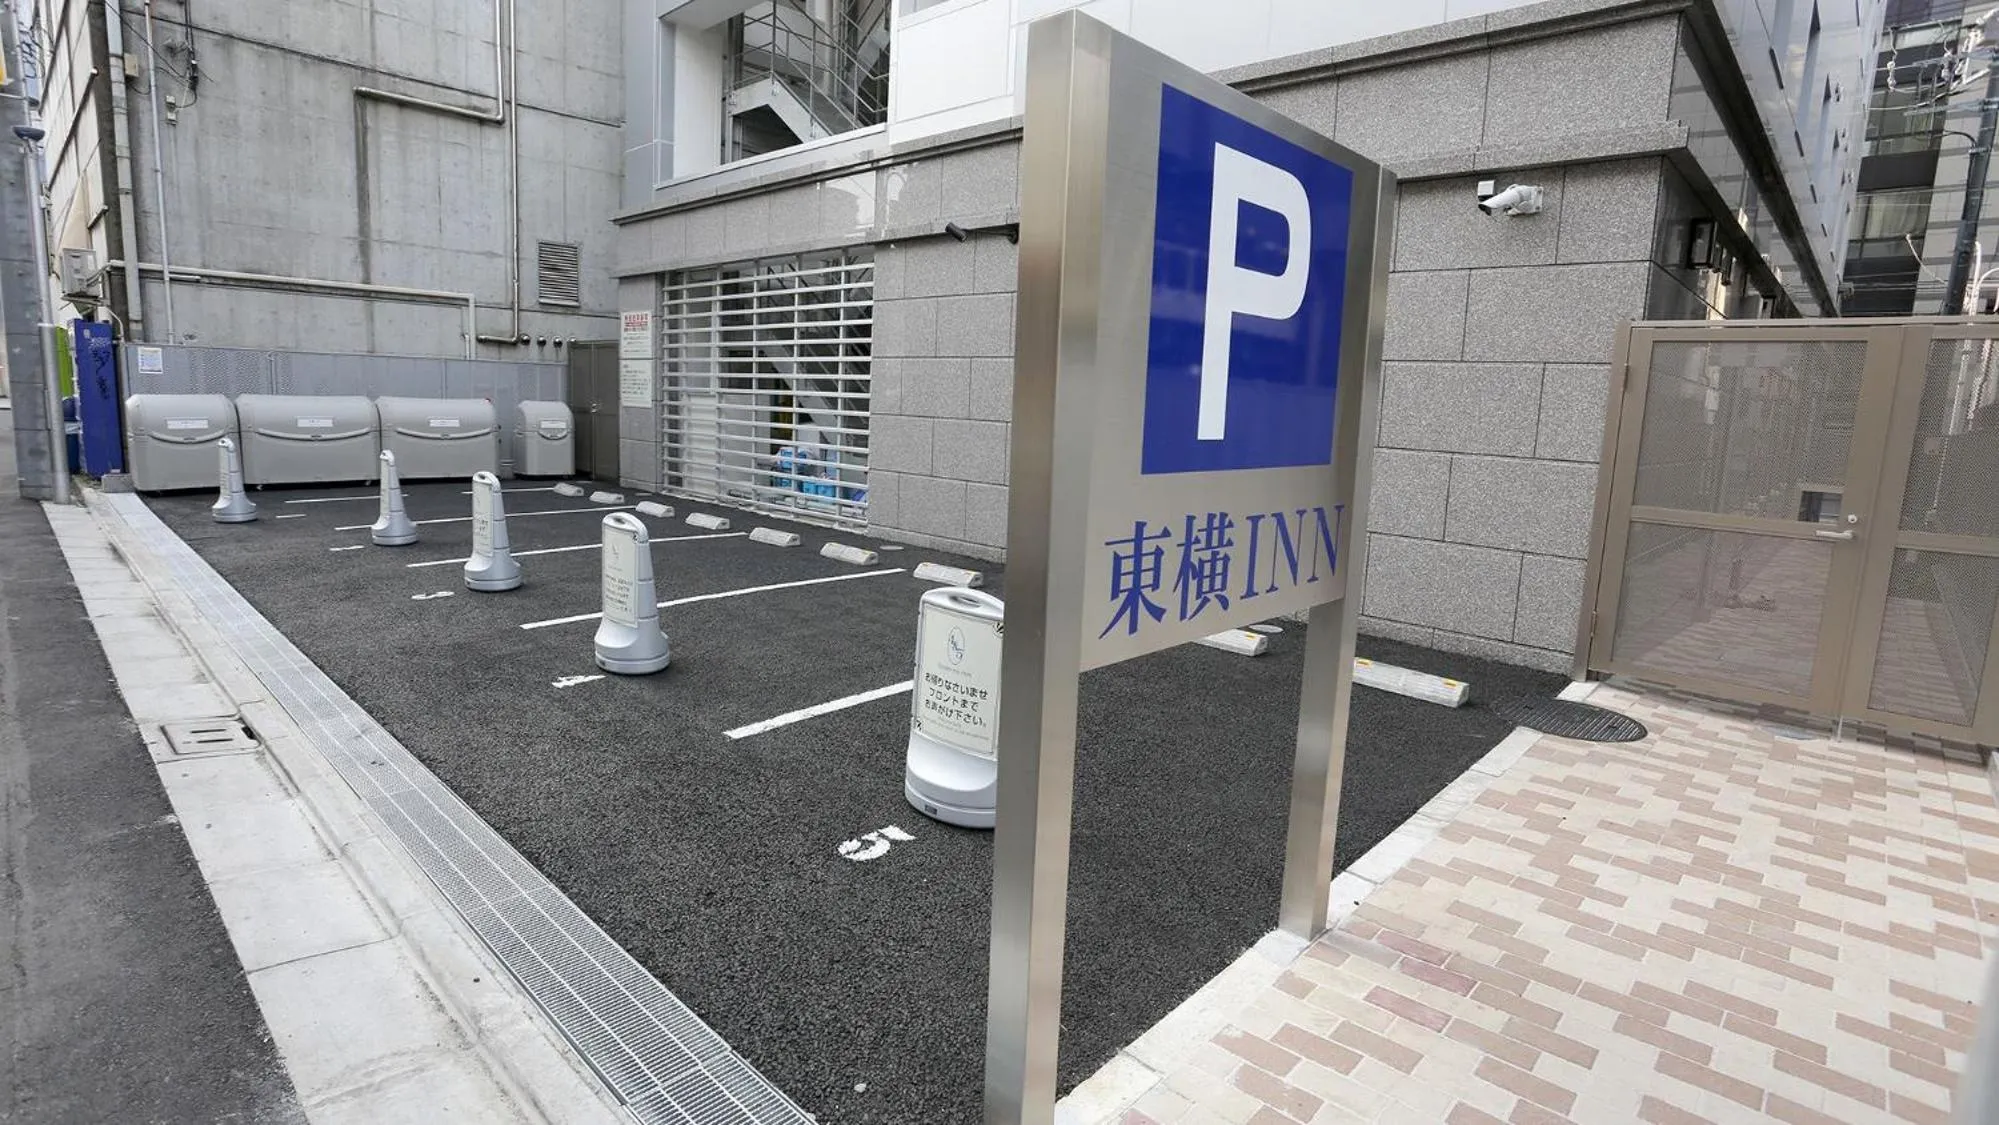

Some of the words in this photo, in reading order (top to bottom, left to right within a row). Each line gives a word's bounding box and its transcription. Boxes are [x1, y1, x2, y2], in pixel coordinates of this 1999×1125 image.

[1198, 142, 1311, 440] P
[1099, 504, 1345, 639] 東横INN
[925, 672, 988, 700] お帰りなさいませ
[929, 687, 978, 712] フロントまで
[838, 824, 917, 861] 5
